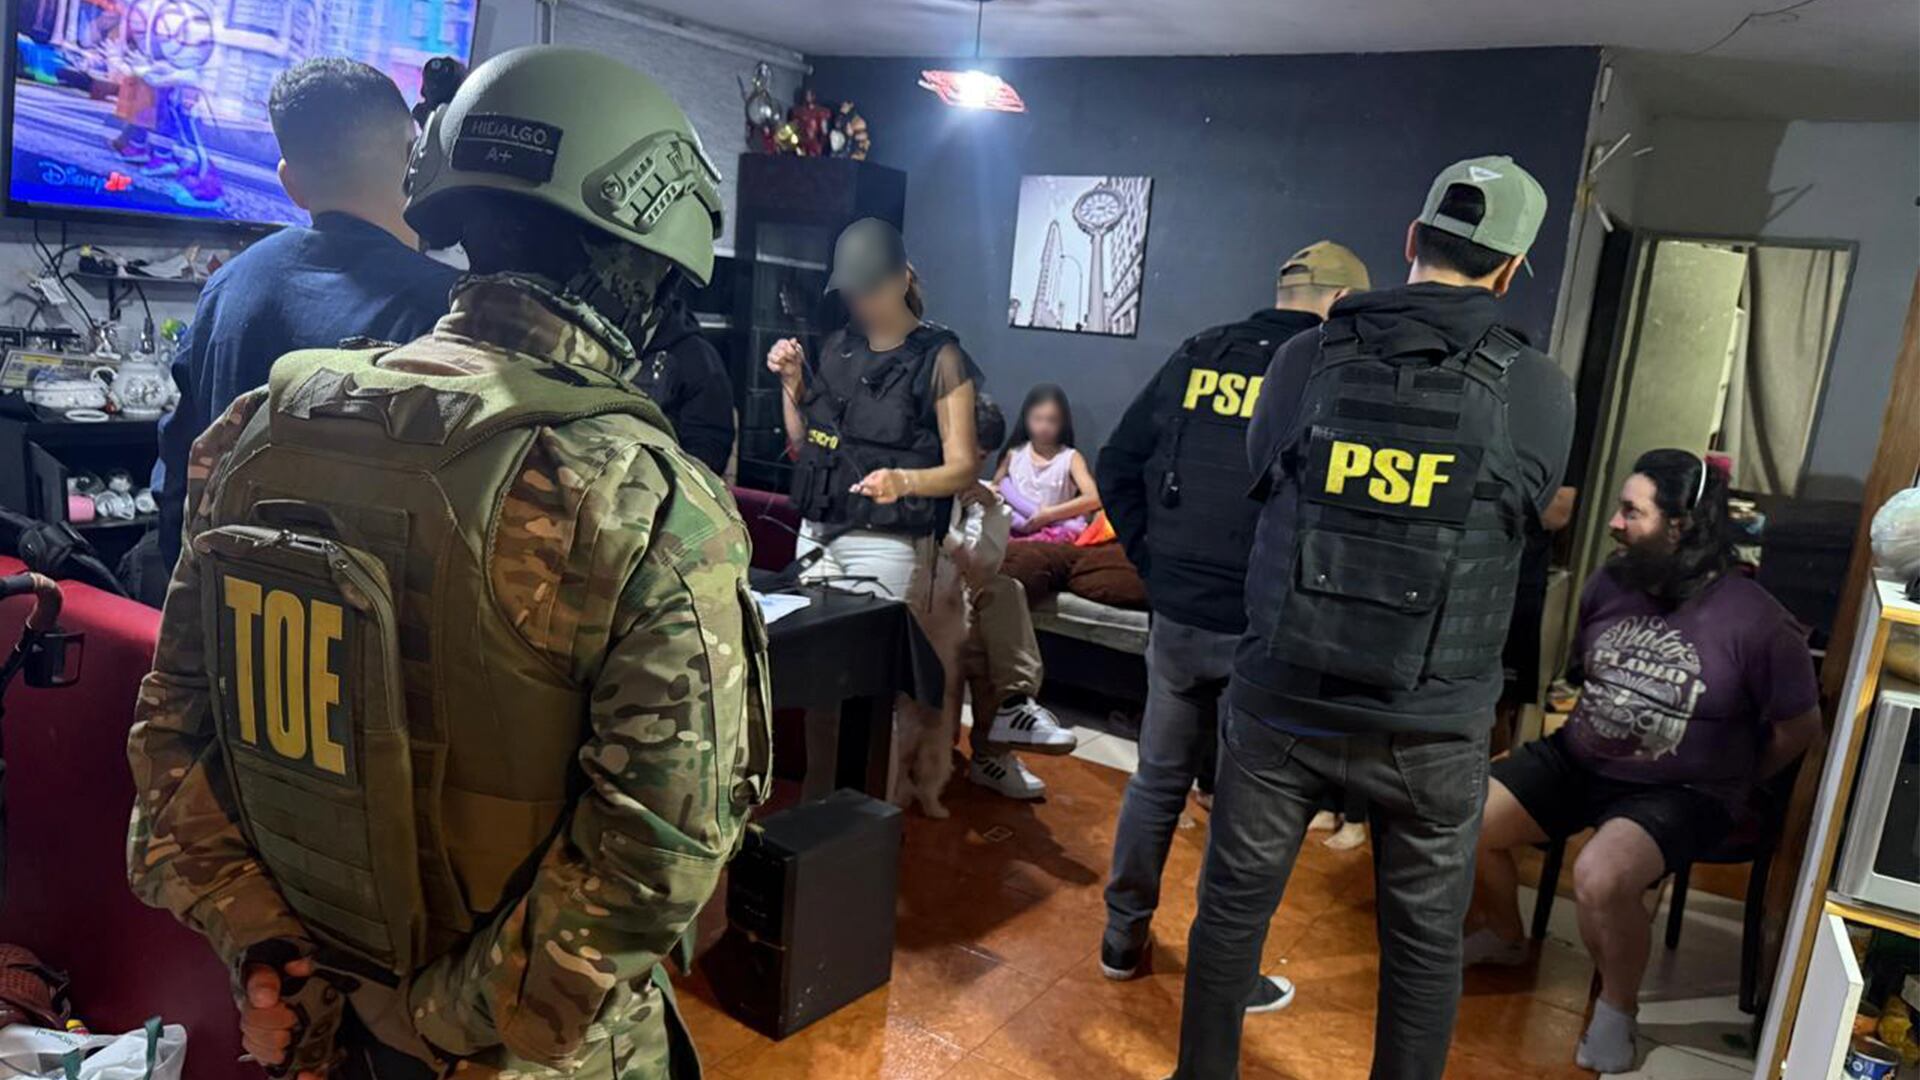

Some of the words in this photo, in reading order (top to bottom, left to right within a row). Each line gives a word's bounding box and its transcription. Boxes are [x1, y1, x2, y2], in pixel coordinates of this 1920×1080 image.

[470, 120, 547, 146] HIDALGO
[486, 147, 513, 164] A+
[1324, 440, 1456, 508] PSF
[223, 575, 346, 776] TOE
